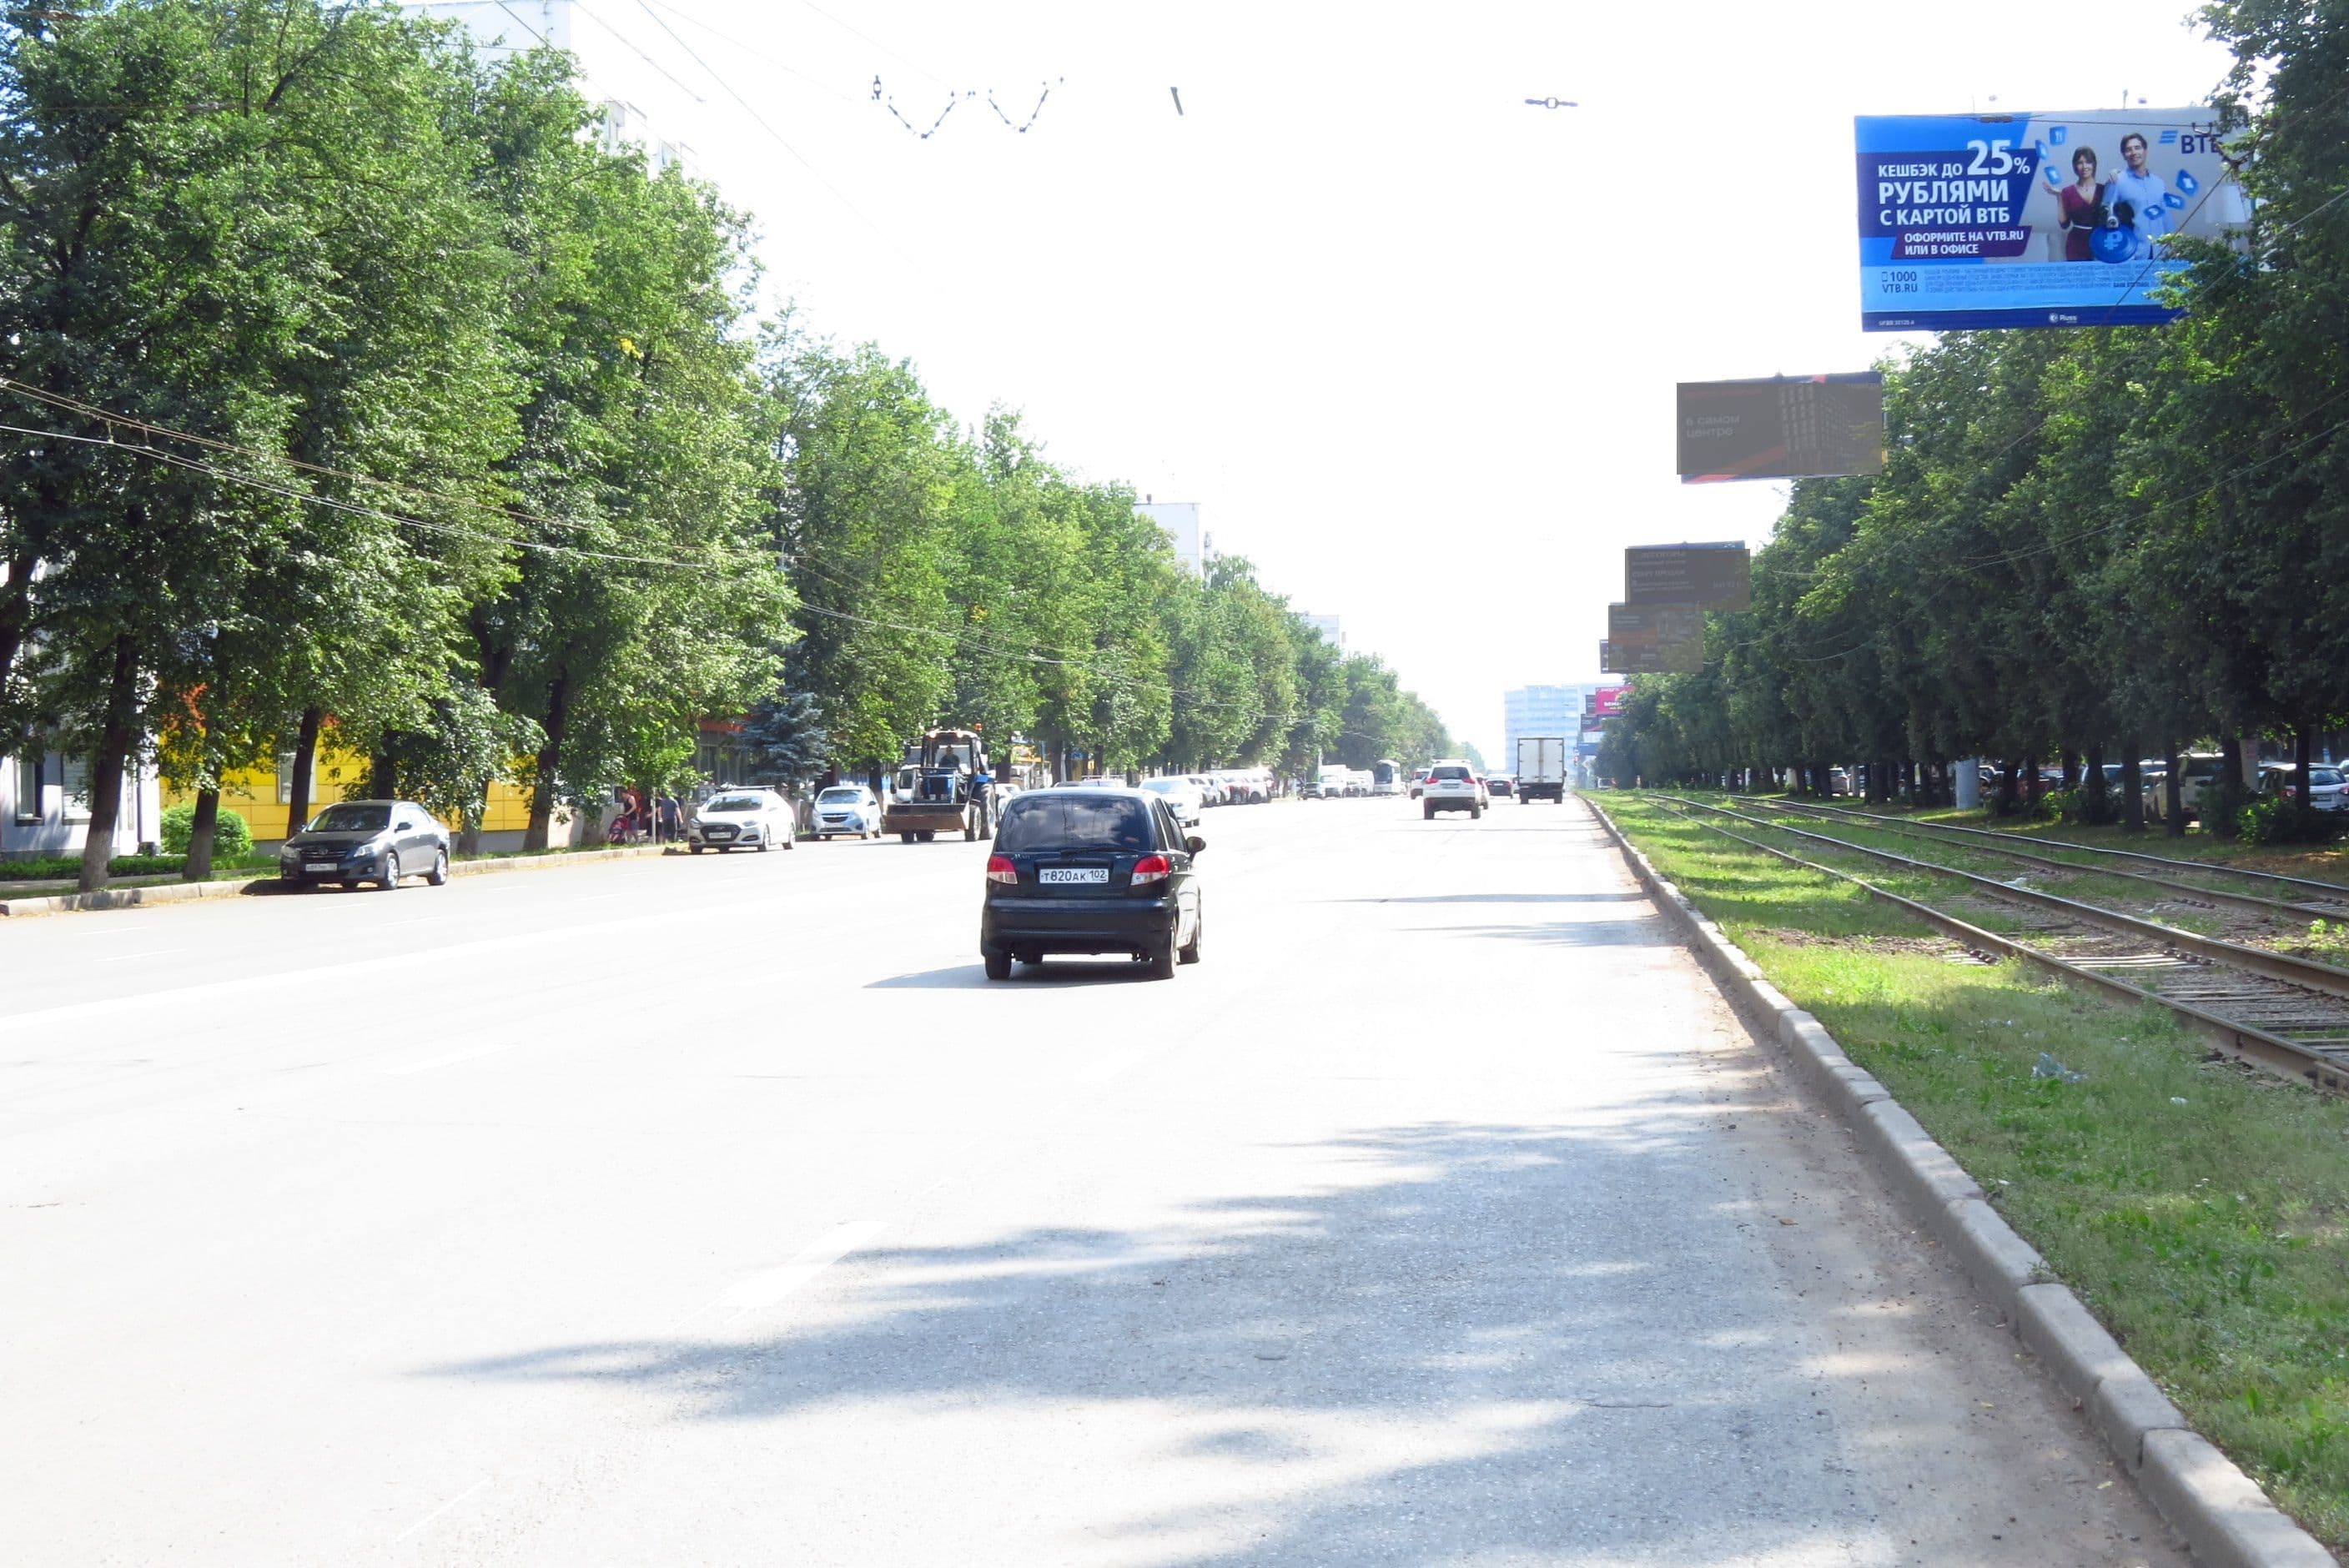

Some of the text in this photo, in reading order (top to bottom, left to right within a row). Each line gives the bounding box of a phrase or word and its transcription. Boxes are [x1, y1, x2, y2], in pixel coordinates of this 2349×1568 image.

[1878, 139, 2030, 178] КЕШБЭК ДО 25%
[1879, 179, 2009, 205] РУБЛЯМИ
[1879, 204, 2010, 226] С КАРТОЙ ВТБ
[1904, 230, 2025, 244] ОФОРМИТЕ НА VTB.RU
[1904, 244, 1979, 256] ИЛИ В ОФИСЕ
[1889, 271, 1917, 282] 1000
[1882, 284, 1918, 294] VTB.RU
[1089, 870, 1105, 879] 102
